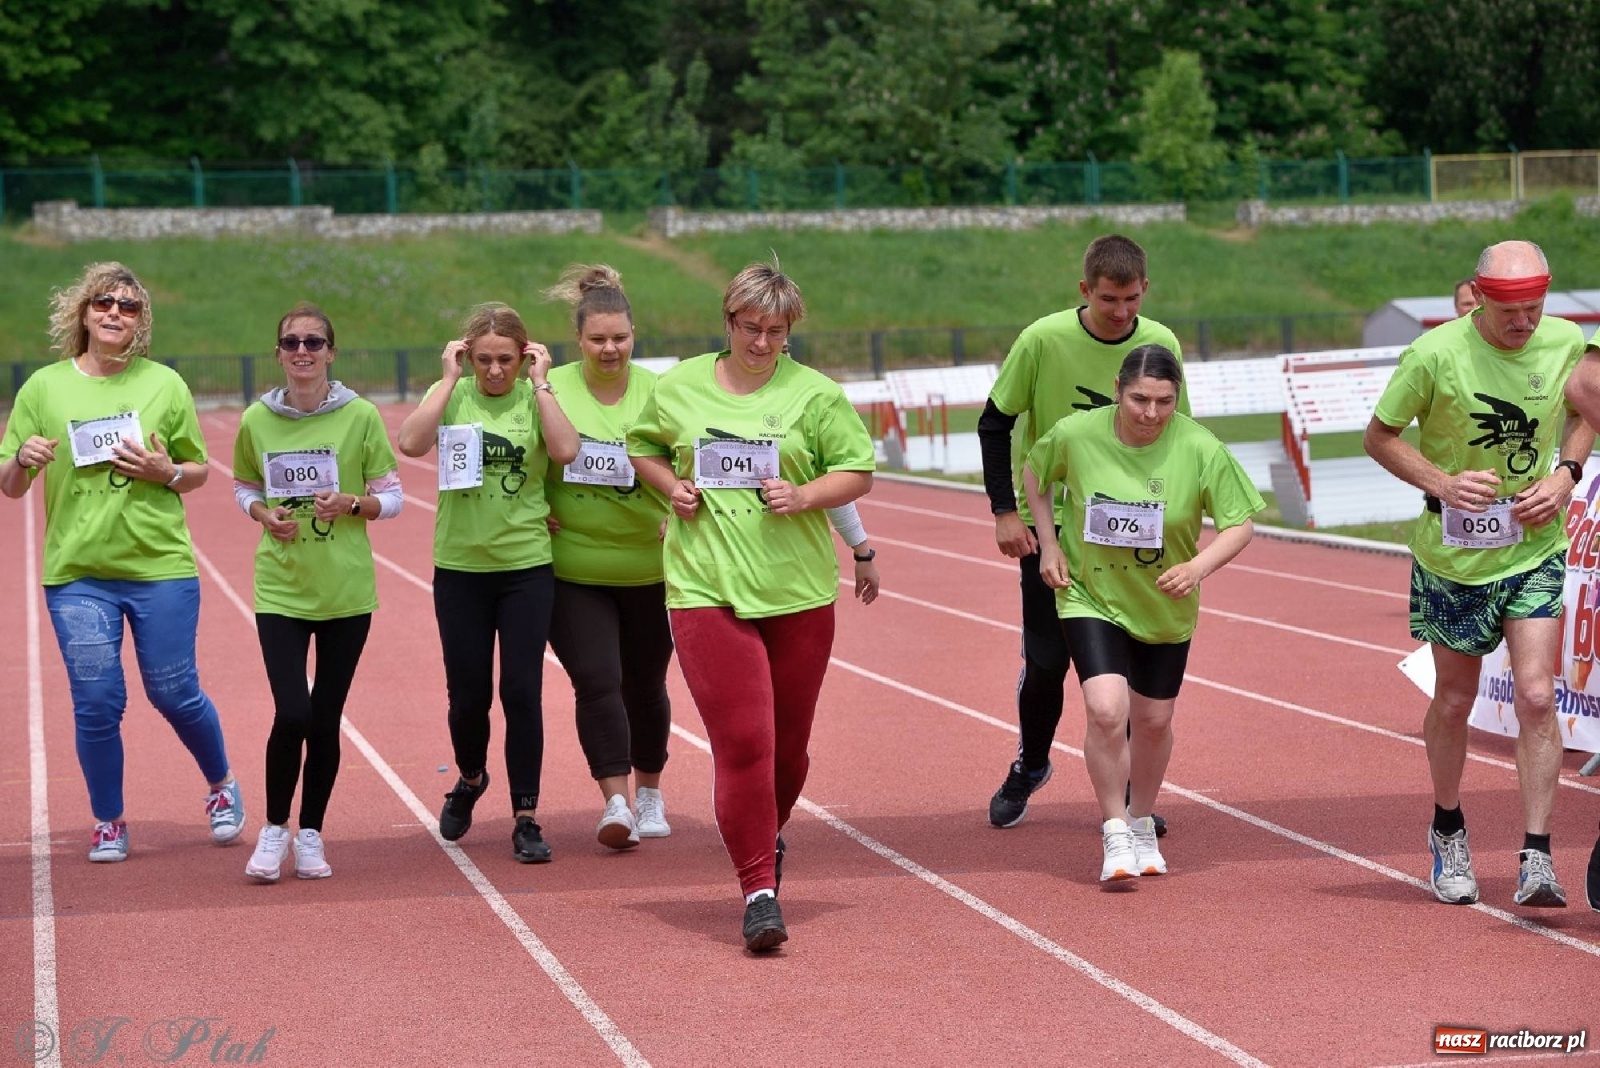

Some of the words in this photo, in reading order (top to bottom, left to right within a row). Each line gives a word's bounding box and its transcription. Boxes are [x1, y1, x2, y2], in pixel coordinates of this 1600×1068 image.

[1499, 420, 1519, 432] VII
[93, 431, 120, 449] 081
[452, 442, 467, 471] 082
[486, 446, 506, 456] VII
[583, 455, 616, 471] 002
[721, 456, 752, 473] 041
[284, 466, 318, 482] 080
[1107, 517, 1139, 533] 076
[1462, 517, 1500, 533] 050
